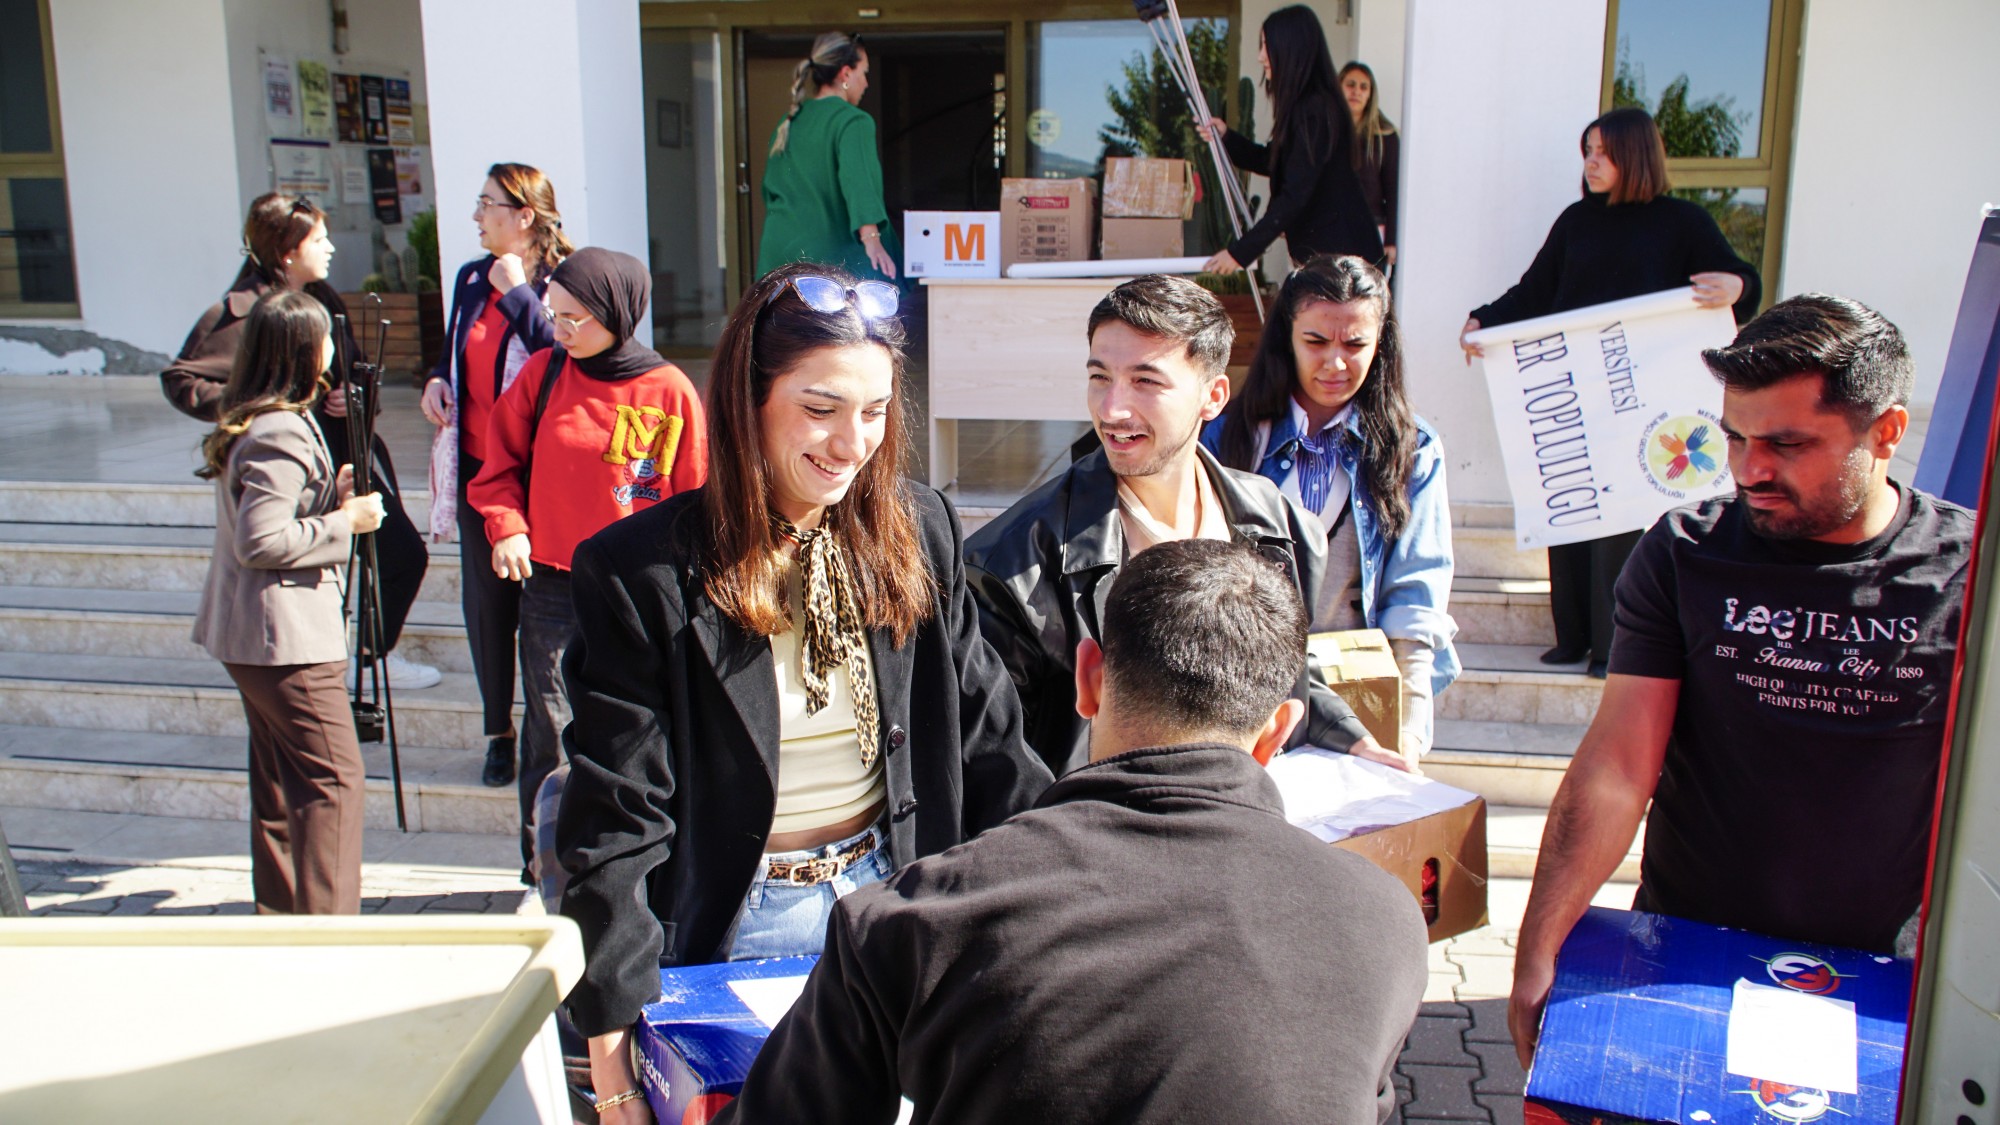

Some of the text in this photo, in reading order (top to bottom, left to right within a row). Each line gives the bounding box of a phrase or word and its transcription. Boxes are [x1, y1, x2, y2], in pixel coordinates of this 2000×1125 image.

[945, 223, 985, 261] M
[1523, 371, 1615, 528] TOPLULUĞU
[1801, 610, 1919, 644] JEANS
[1714, 644, 1739, 659] EST.
[1895, 666, 1924, 679] 1889
[1843, 648, 1860, 656] LEE
[1809, 698, 1838, 714] FOR
